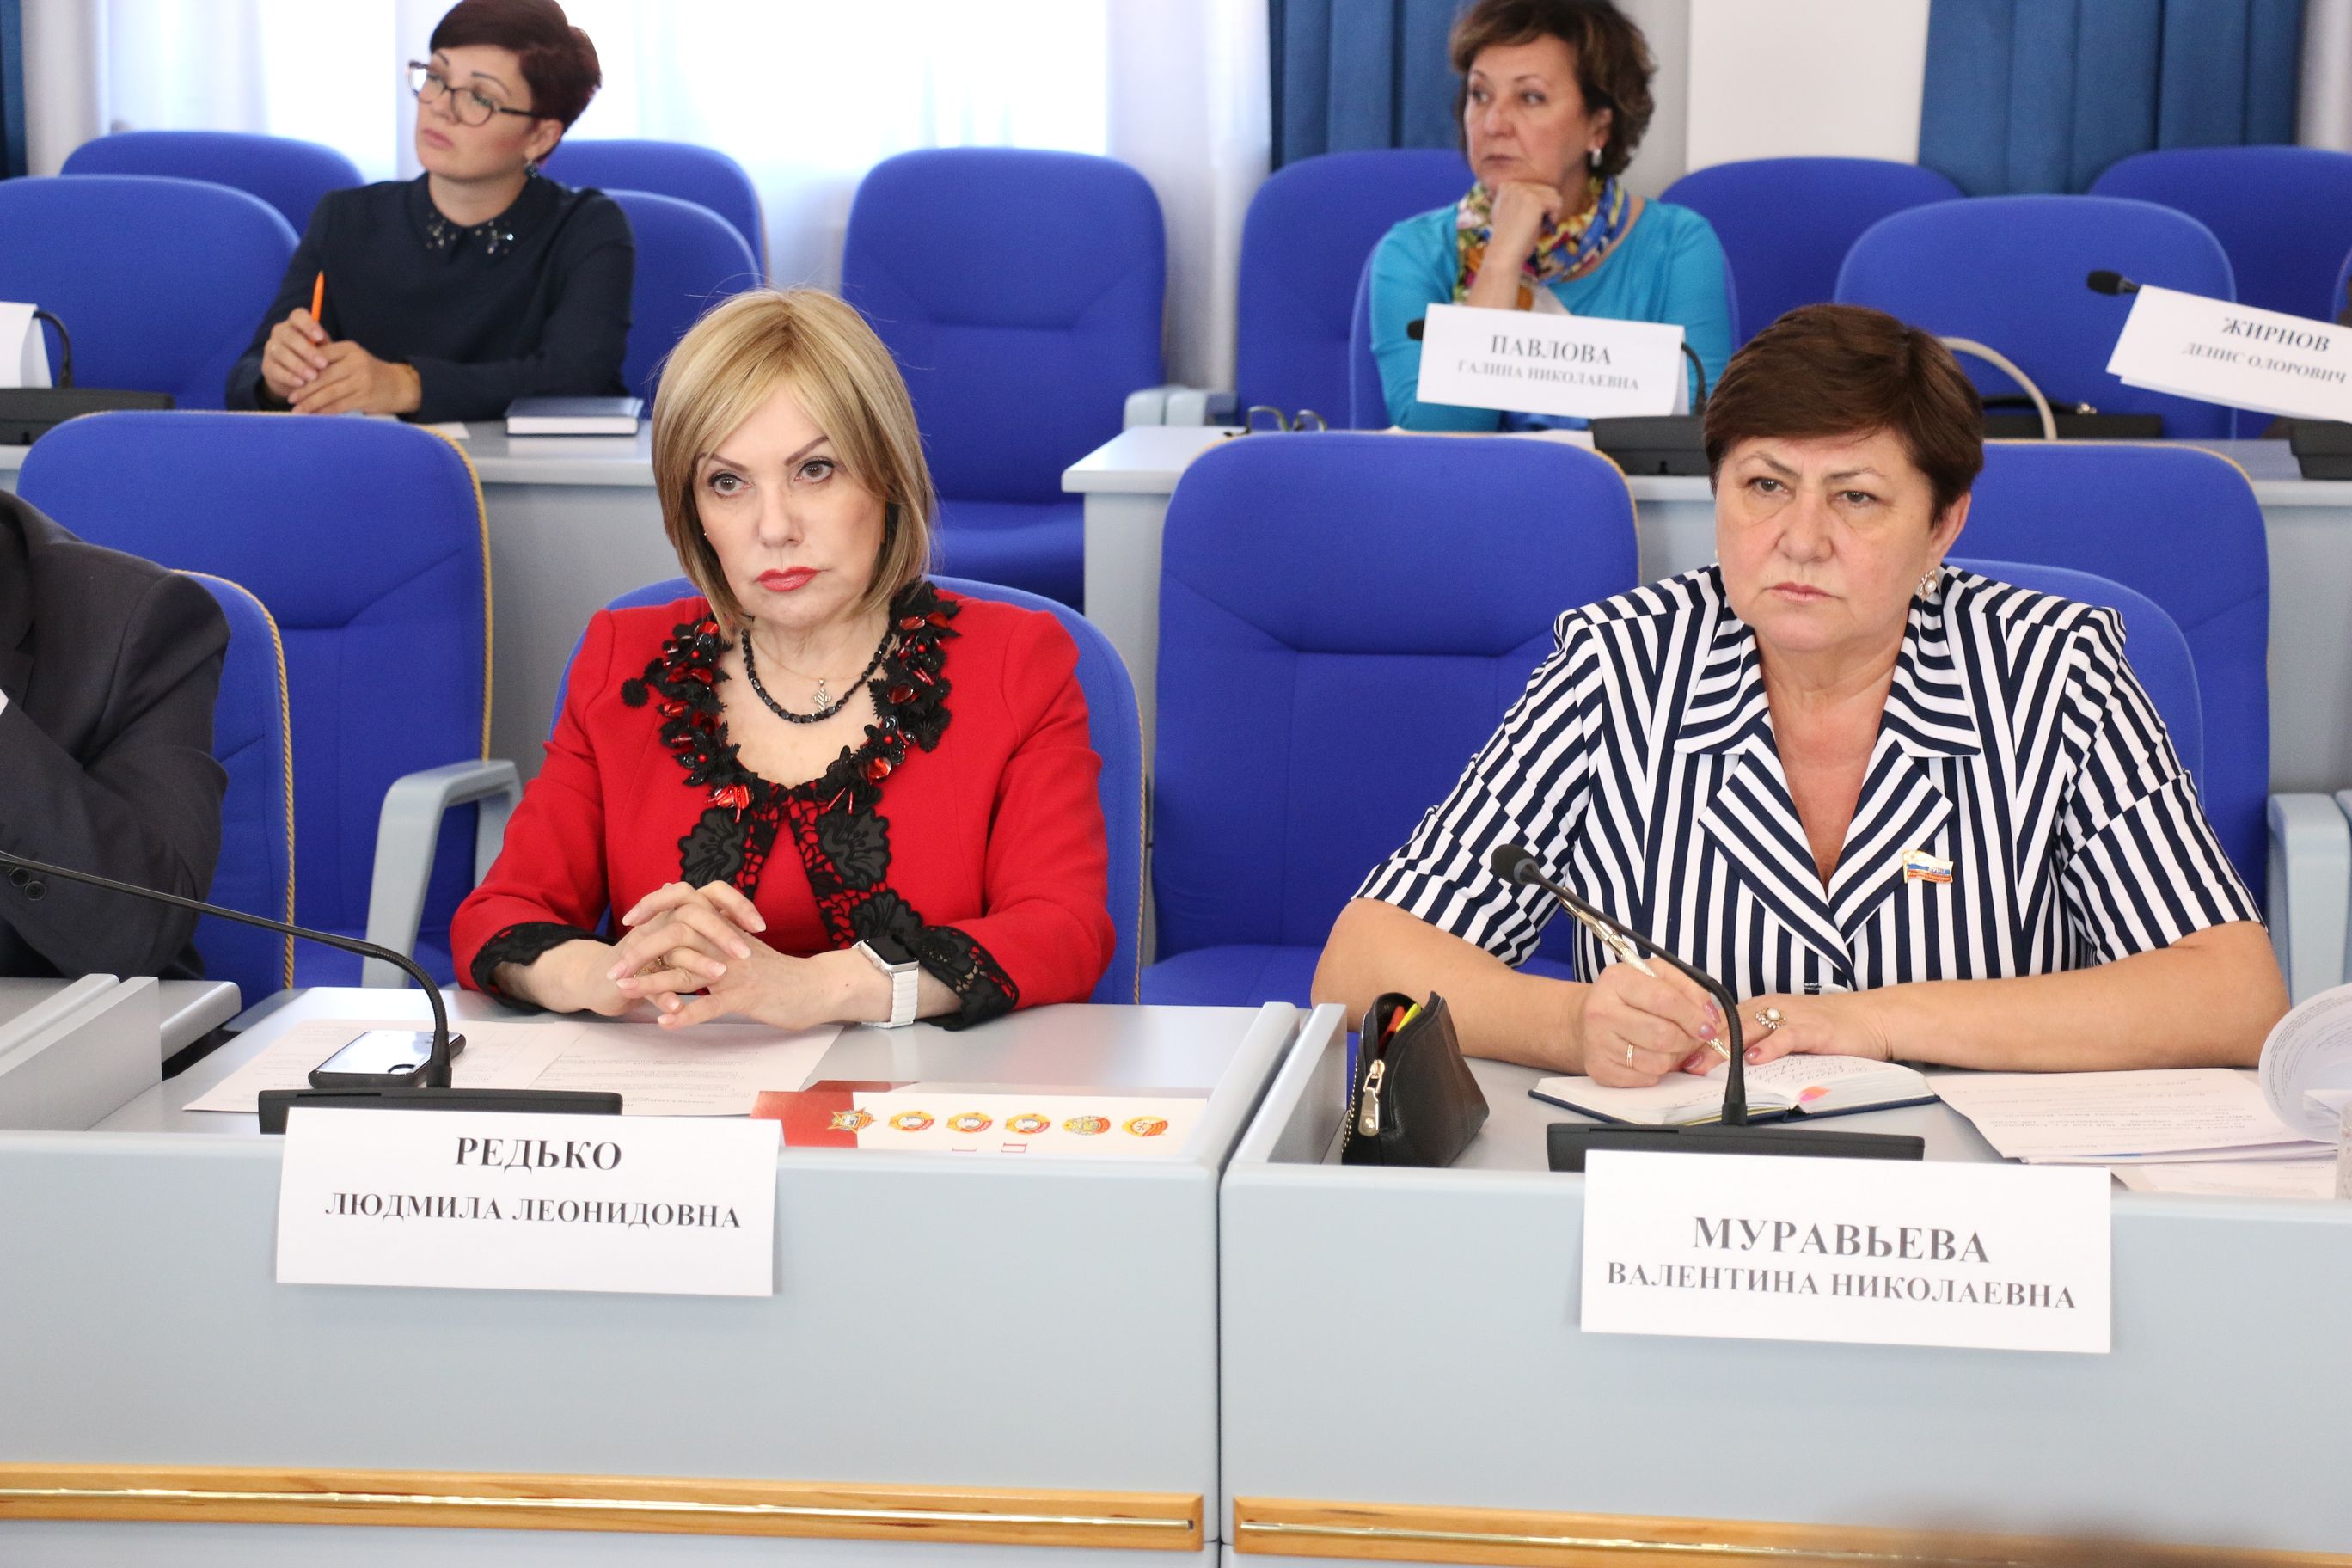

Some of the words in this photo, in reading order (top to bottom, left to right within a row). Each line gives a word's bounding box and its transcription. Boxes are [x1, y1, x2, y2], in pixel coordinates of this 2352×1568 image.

[1490, 334, 1612, 365] ПАВЛОВА
[2221, 316, 2331, 352] ЖИРНОВ
[2182, 342, 2245, 364] ДЕНИС
[1457, 359, 1523, 378] ГАЛИНА
[1527, 367, 1639, 390] НИКОЛАЕВНА
[455, 1137, 622, 1173] РЕДЬКО
[325, 1192, 502, 1220] ЛЮДМИЛА
[512, 1199, 741, 1229] ЛЕОНИДОВНА
[1692, 1216, 1989, 1264] МУРАВЬЕВА
[1607, 1262, 1819, 1295] ВАЛЕНТИНА
[1831, 1273, 2076, 1309] НИКОЛАЕВНА
